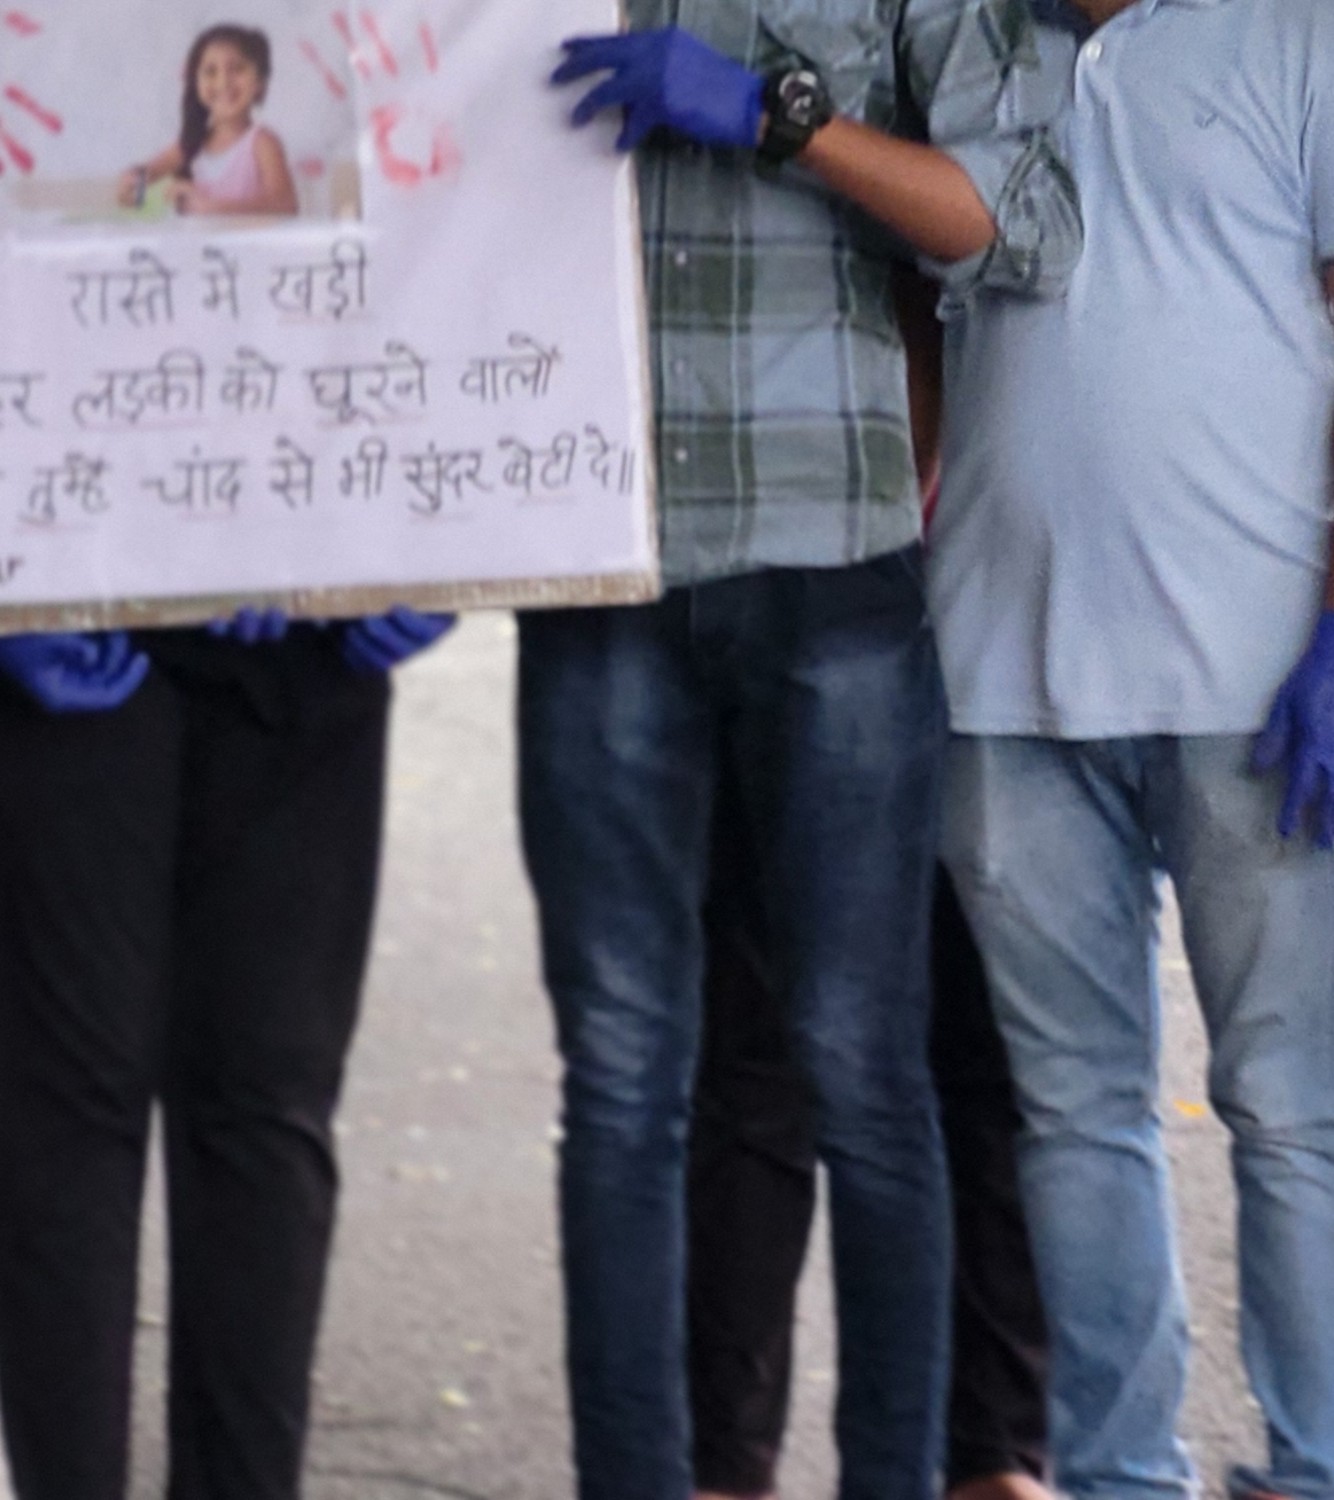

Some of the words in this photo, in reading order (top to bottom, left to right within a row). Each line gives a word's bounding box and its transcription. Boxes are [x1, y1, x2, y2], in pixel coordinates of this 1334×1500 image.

[67, 247, 174, 328] रास्ते
[220, 345, 283, 414] को
[140, 444, 248, 512] चांद
[270, 435, 315, 508] से
[339, 436, 387, 498] भी
[400, 440, 495, 515] सुंदर
[497, 431, 577, 493] बेटी
